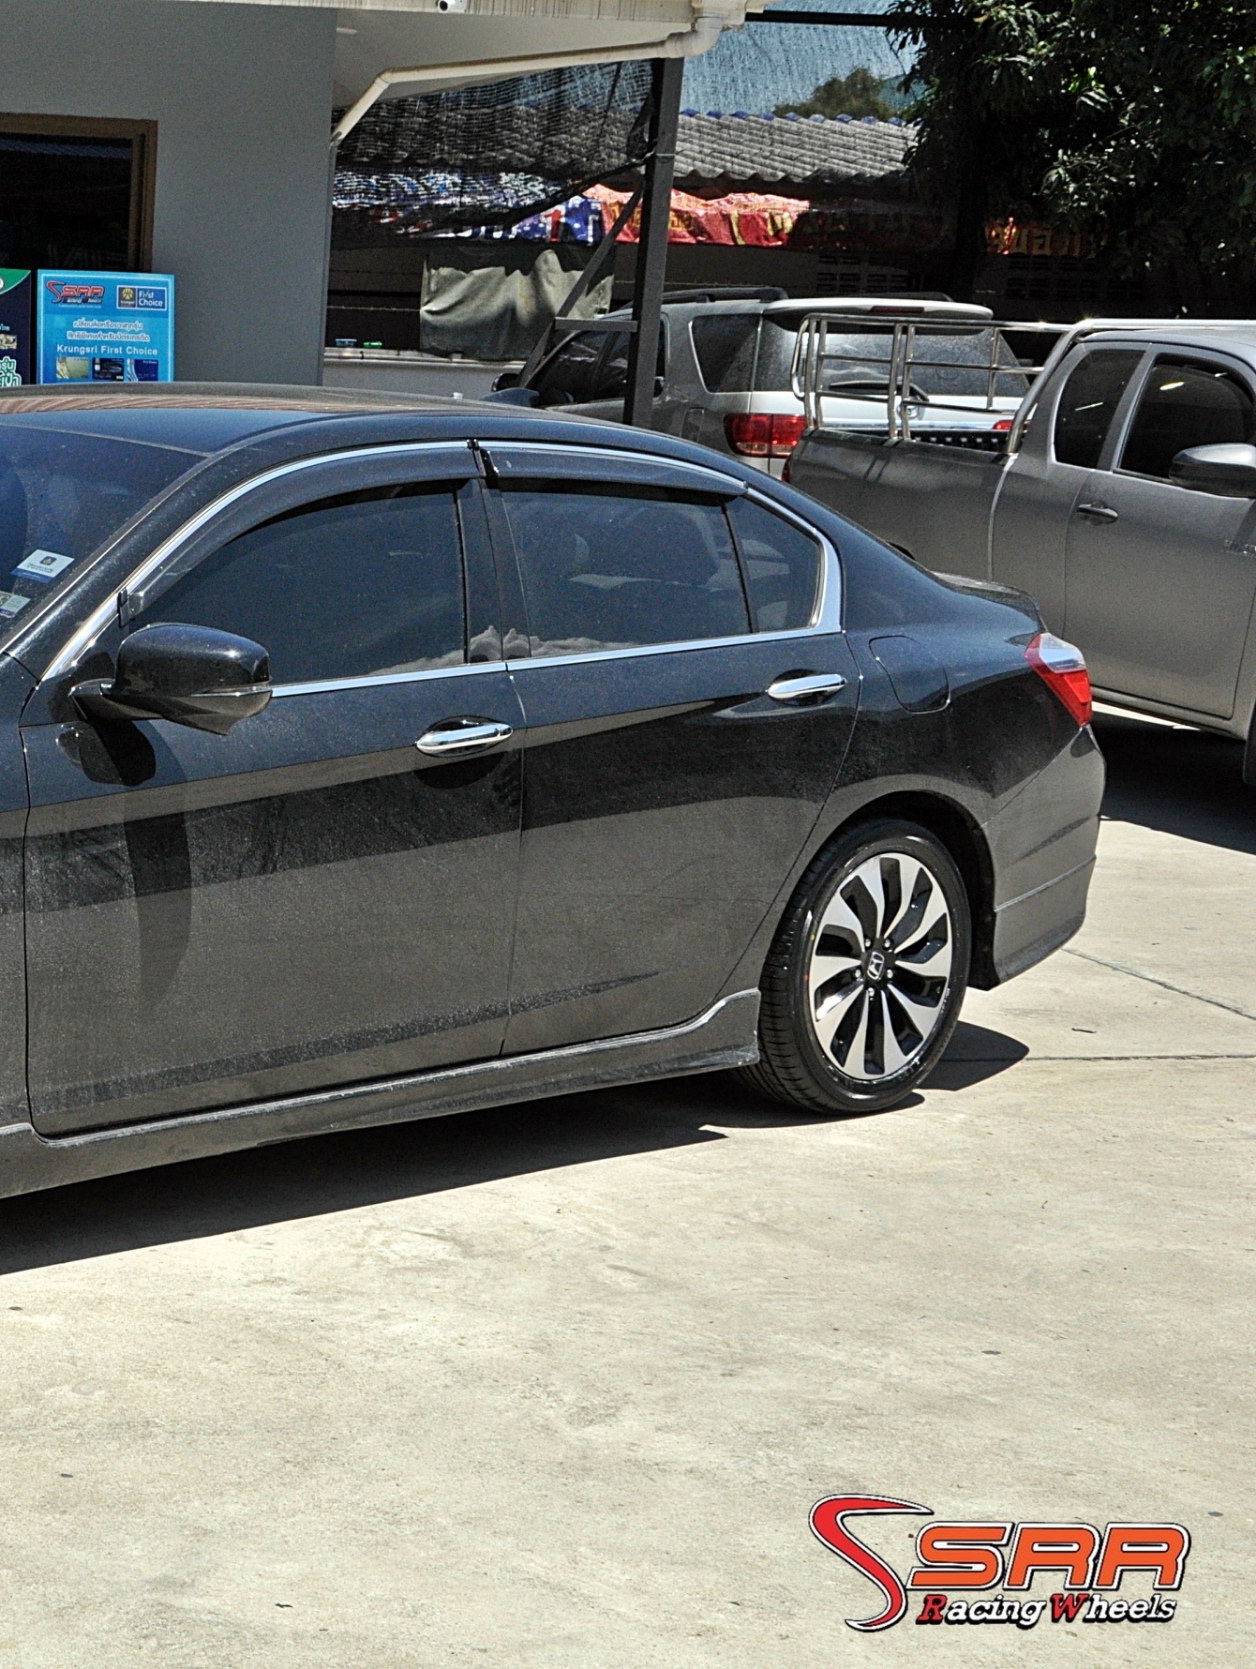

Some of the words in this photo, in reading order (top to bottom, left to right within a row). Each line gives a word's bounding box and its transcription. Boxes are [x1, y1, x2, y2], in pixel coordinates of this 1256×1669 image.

[138, 298, 163, 307] Choice
[57, 344, 97, 355] Krungsri
[101, 345, 122, 354] First
[126, 346, 158, 355] Choice
